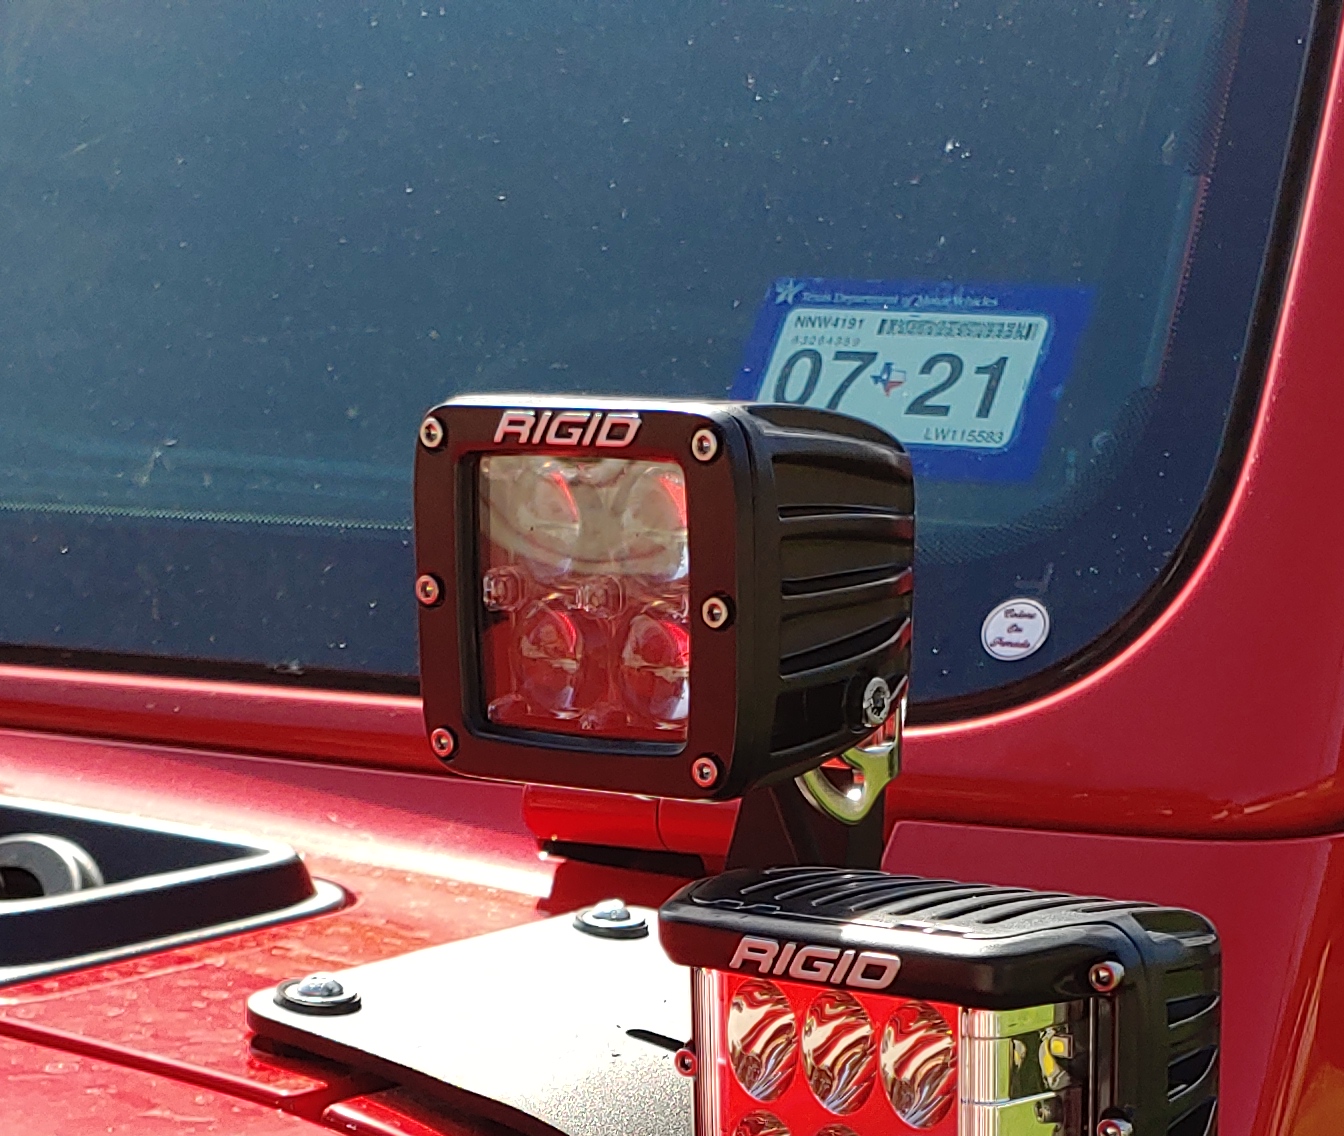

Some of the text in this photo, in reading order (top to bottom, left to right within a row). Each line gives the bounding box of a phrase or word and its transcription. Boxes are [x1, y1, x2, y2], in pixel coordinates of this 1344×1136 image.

[794, 315, 865, 330] NNW4191
[773, 348, 1010, 419] 07 21
[492, 409, 643, 448] RIGID
[728, 935, 902, 991] RIGID
